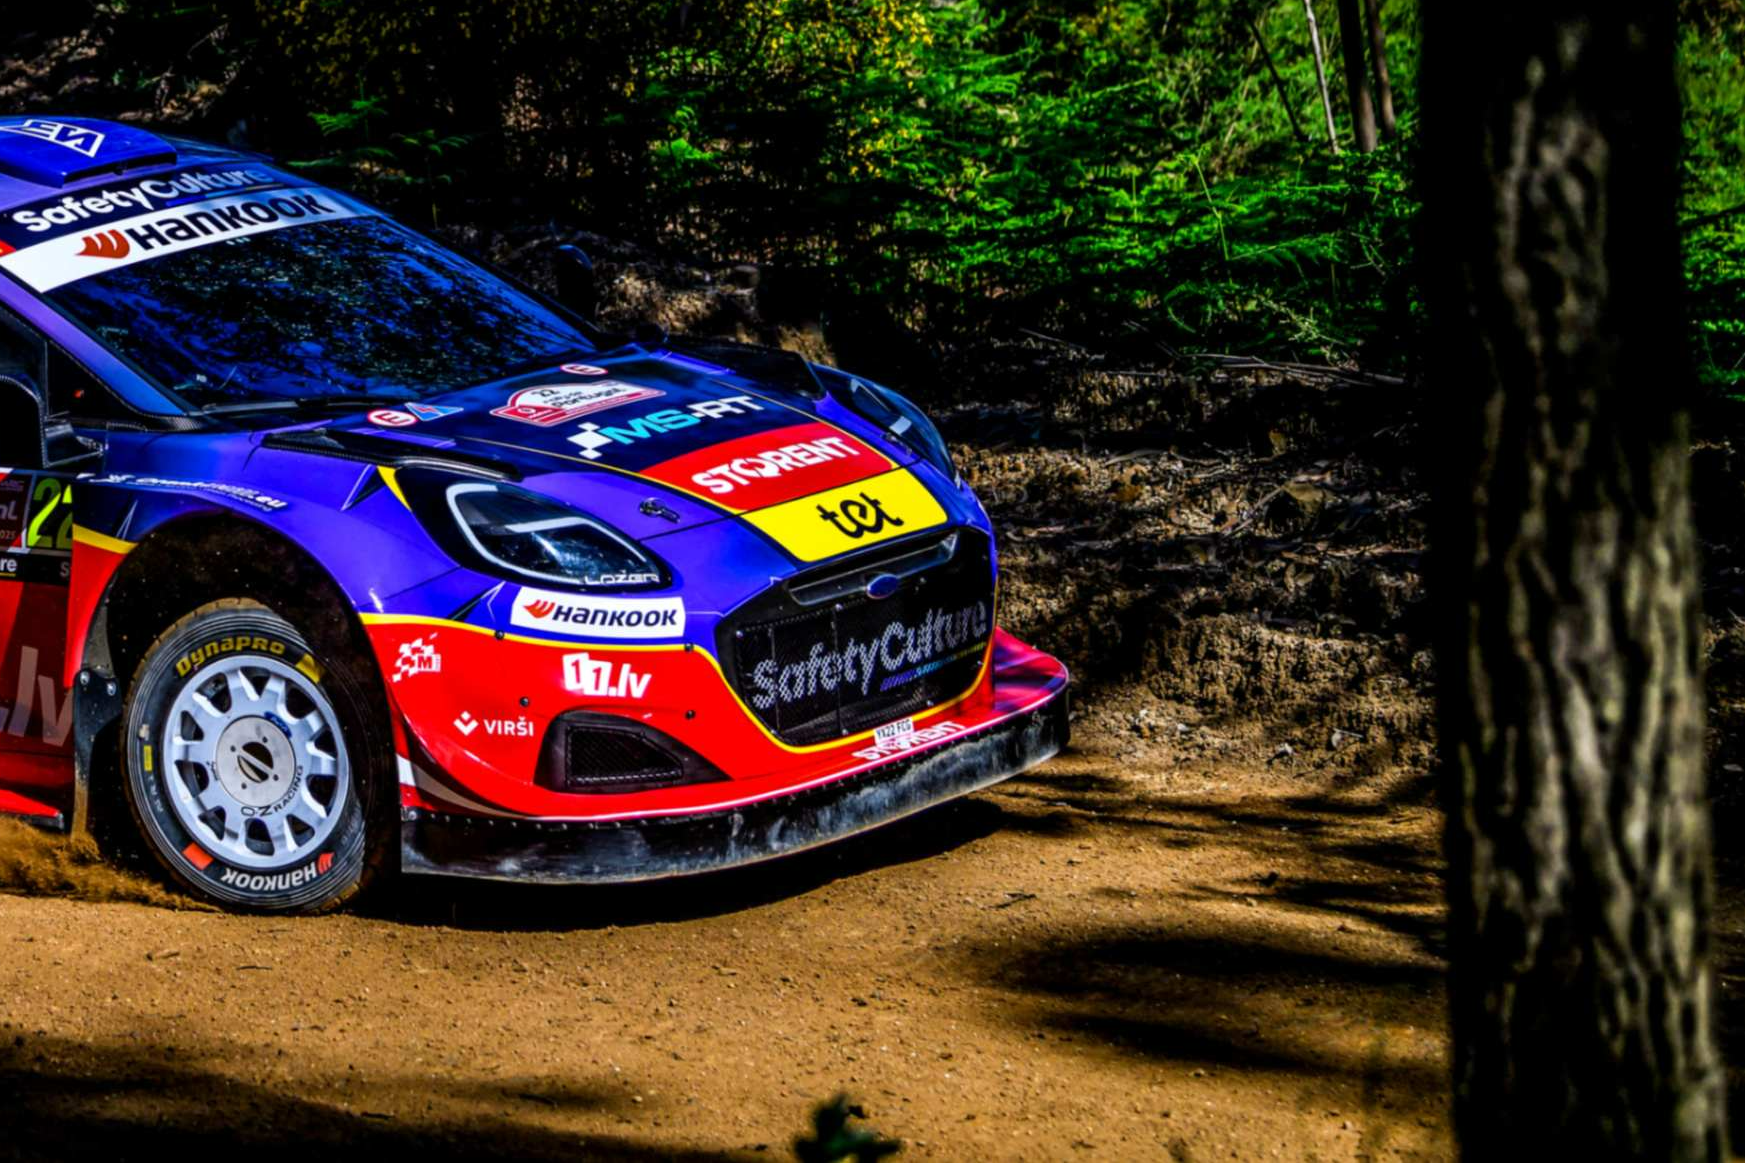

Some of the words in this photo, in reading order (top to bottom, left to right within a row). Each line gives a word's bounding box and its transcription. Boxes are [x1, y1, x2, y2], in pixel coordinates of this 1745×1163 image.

[11, 167, 274, 233] SafetyCulture
[691, 436, 860, 495] STORENT
[816, 492, 904, 540] tet
[752, 601, 988, 710] SafetyCulture
[483, 716, 534, 737] VIRŠI
